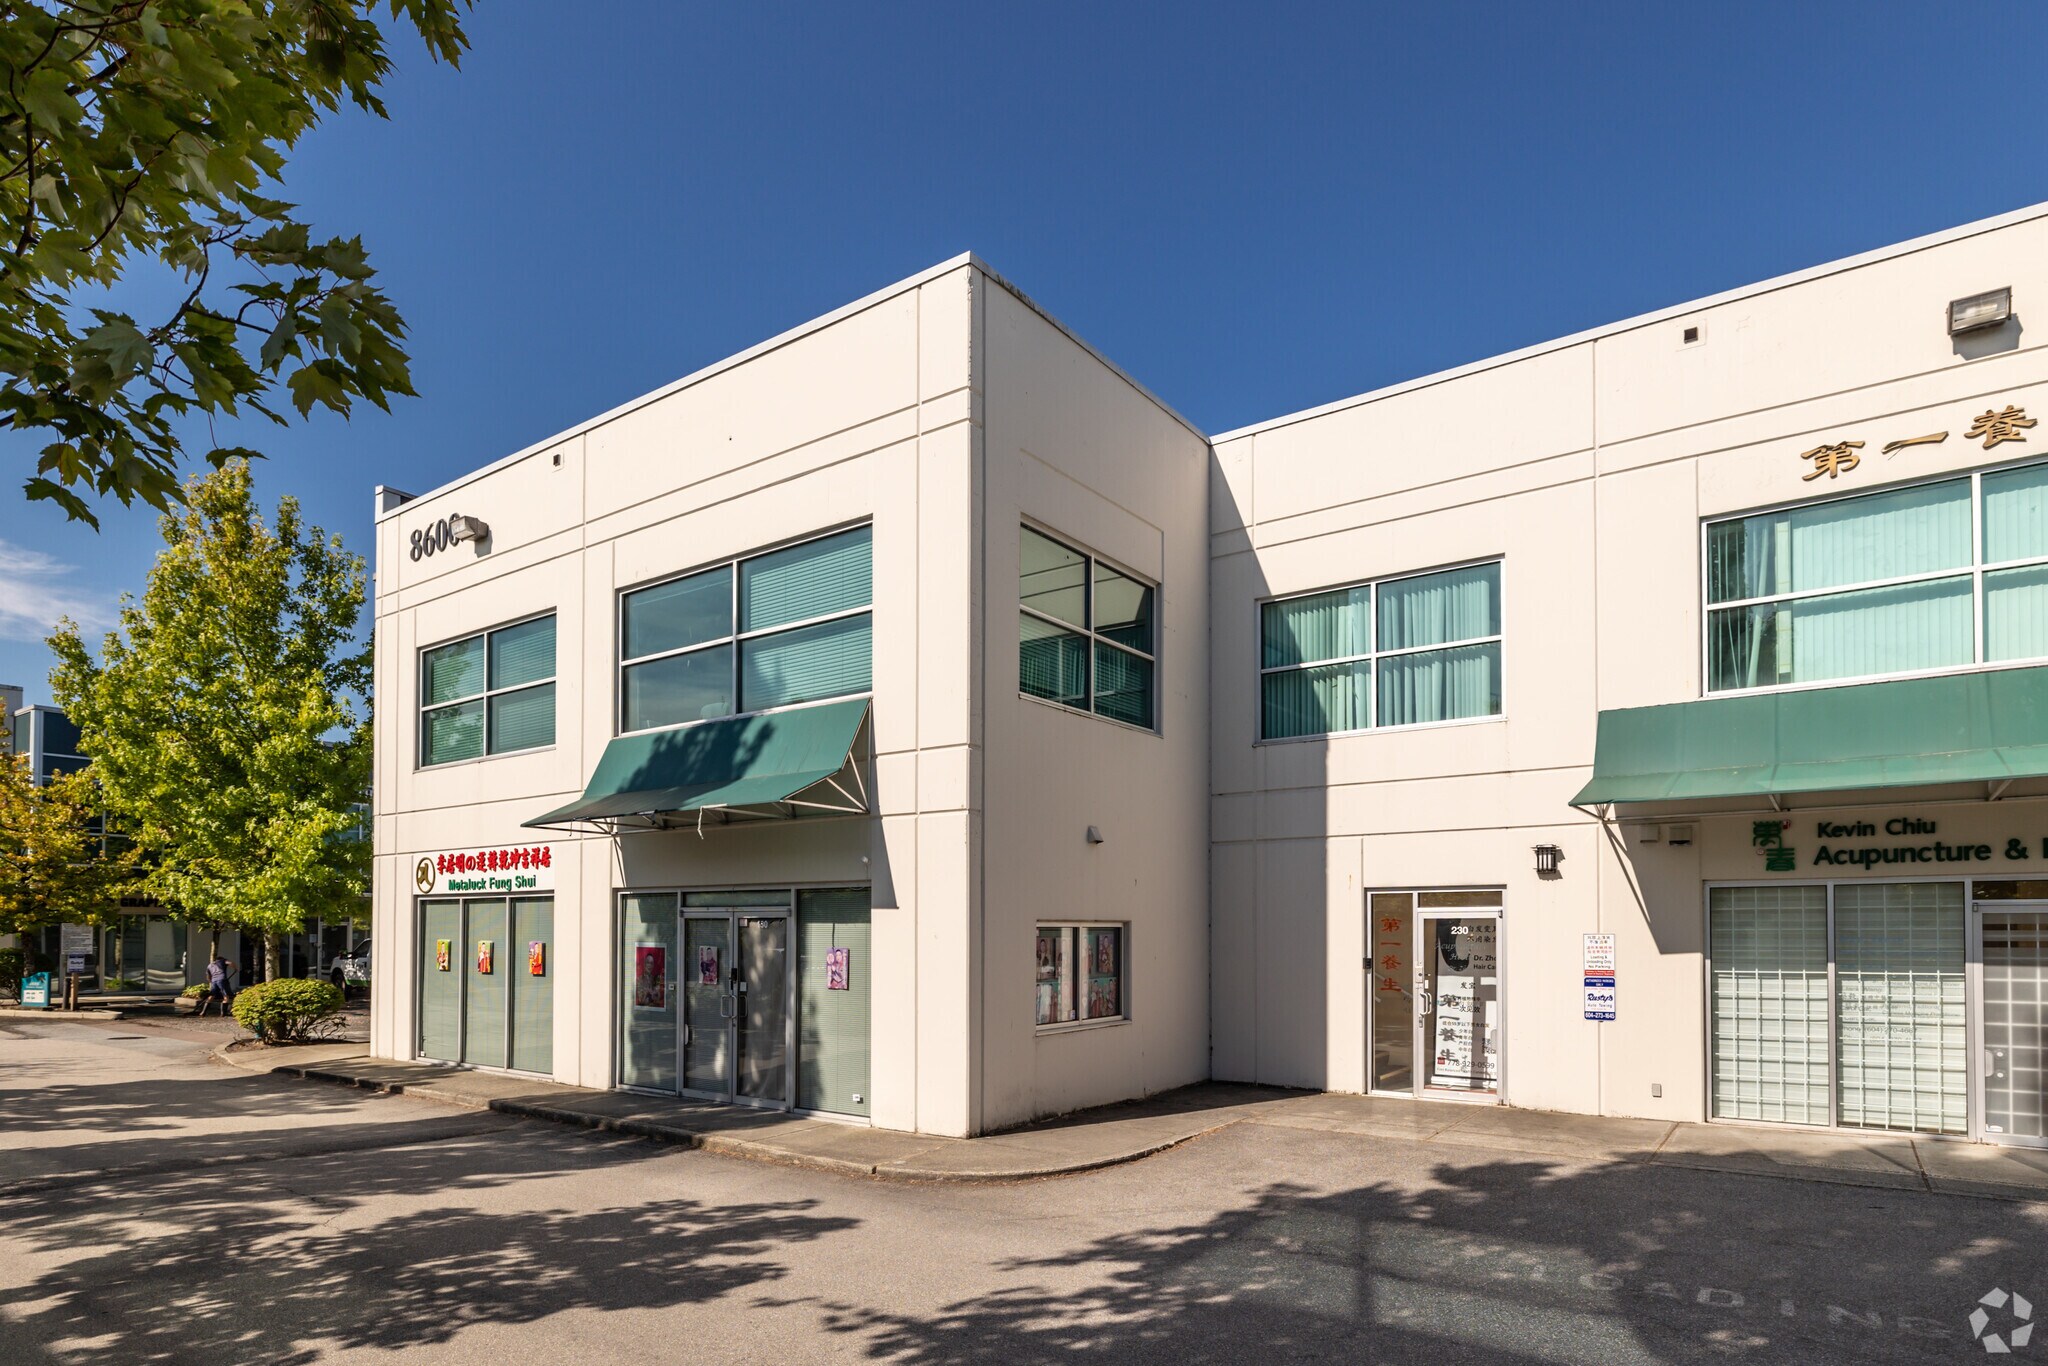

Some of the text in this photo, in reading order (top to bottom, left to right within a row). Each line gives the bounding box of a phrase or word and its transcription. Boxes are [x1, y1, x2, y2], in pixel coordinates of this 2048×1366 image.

[1817, 818, 1937, 839] Kevin Chiu
[1813, 841, 1993, 871] Acupuncture
[2004, 838, 2029, 861] &
[448, 875, 537, 892] Metaluck Fung Shui
[1451, 926, 1469, 935] 230
